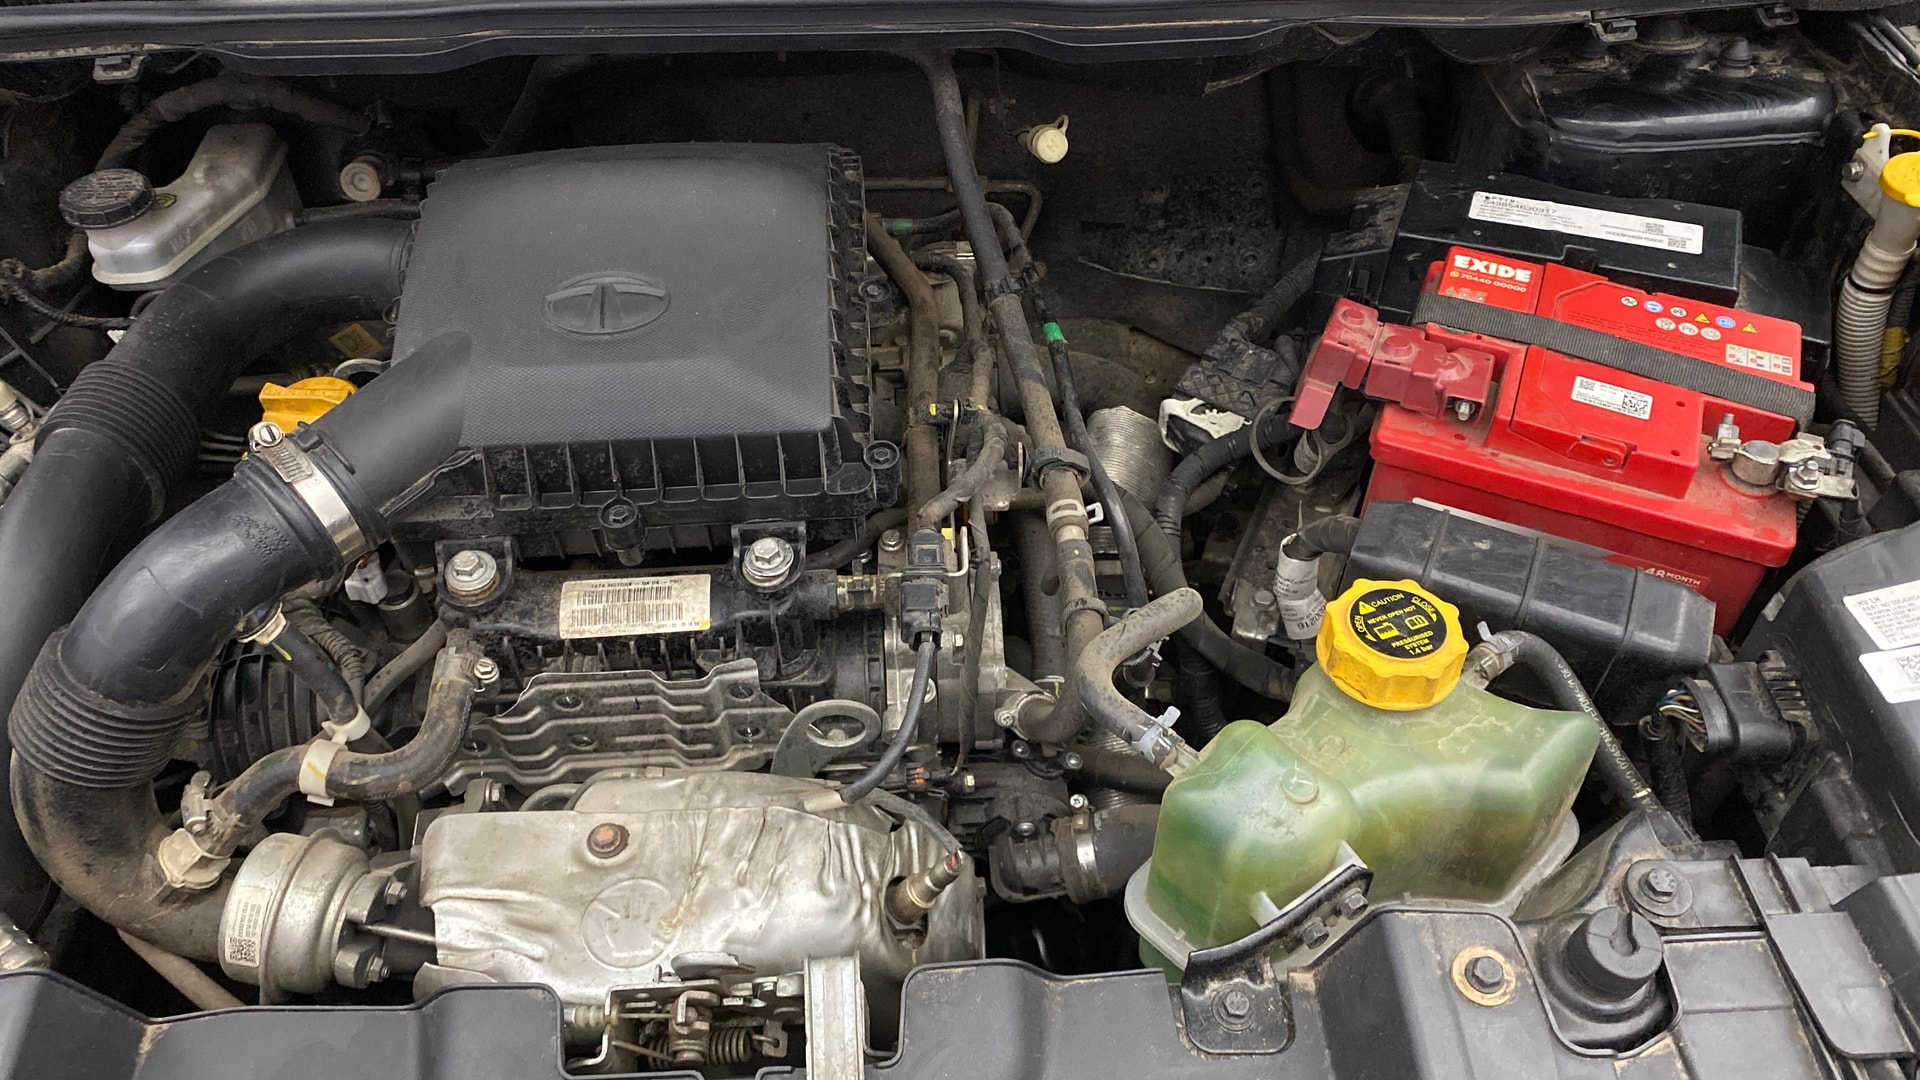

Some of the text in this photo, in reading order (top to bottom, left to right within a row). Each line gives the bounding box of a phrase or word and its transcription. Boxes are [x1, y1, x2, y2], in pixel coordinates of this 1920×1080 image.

[1454, 254, 1532, 283] EXIDE
[1461, 273, 1491, 285] 70440
[1493, 280, 1527, 292] 00000
[1666, 572, 1700, 585] MONTH
[1371, 593, 1404, 607] CAUTION
[1411, 596, 1436, 613] CLOSE
[1367, 605, 1417, 624] NEVER OPEN HOT
[1354, 615, 1365, 633] OPEN
[1391, 631, 1434, 648] PRESSURISED
[1404, 639, 1430, 650] SYSTEM
[1421, 644, 1434, 652] bar
